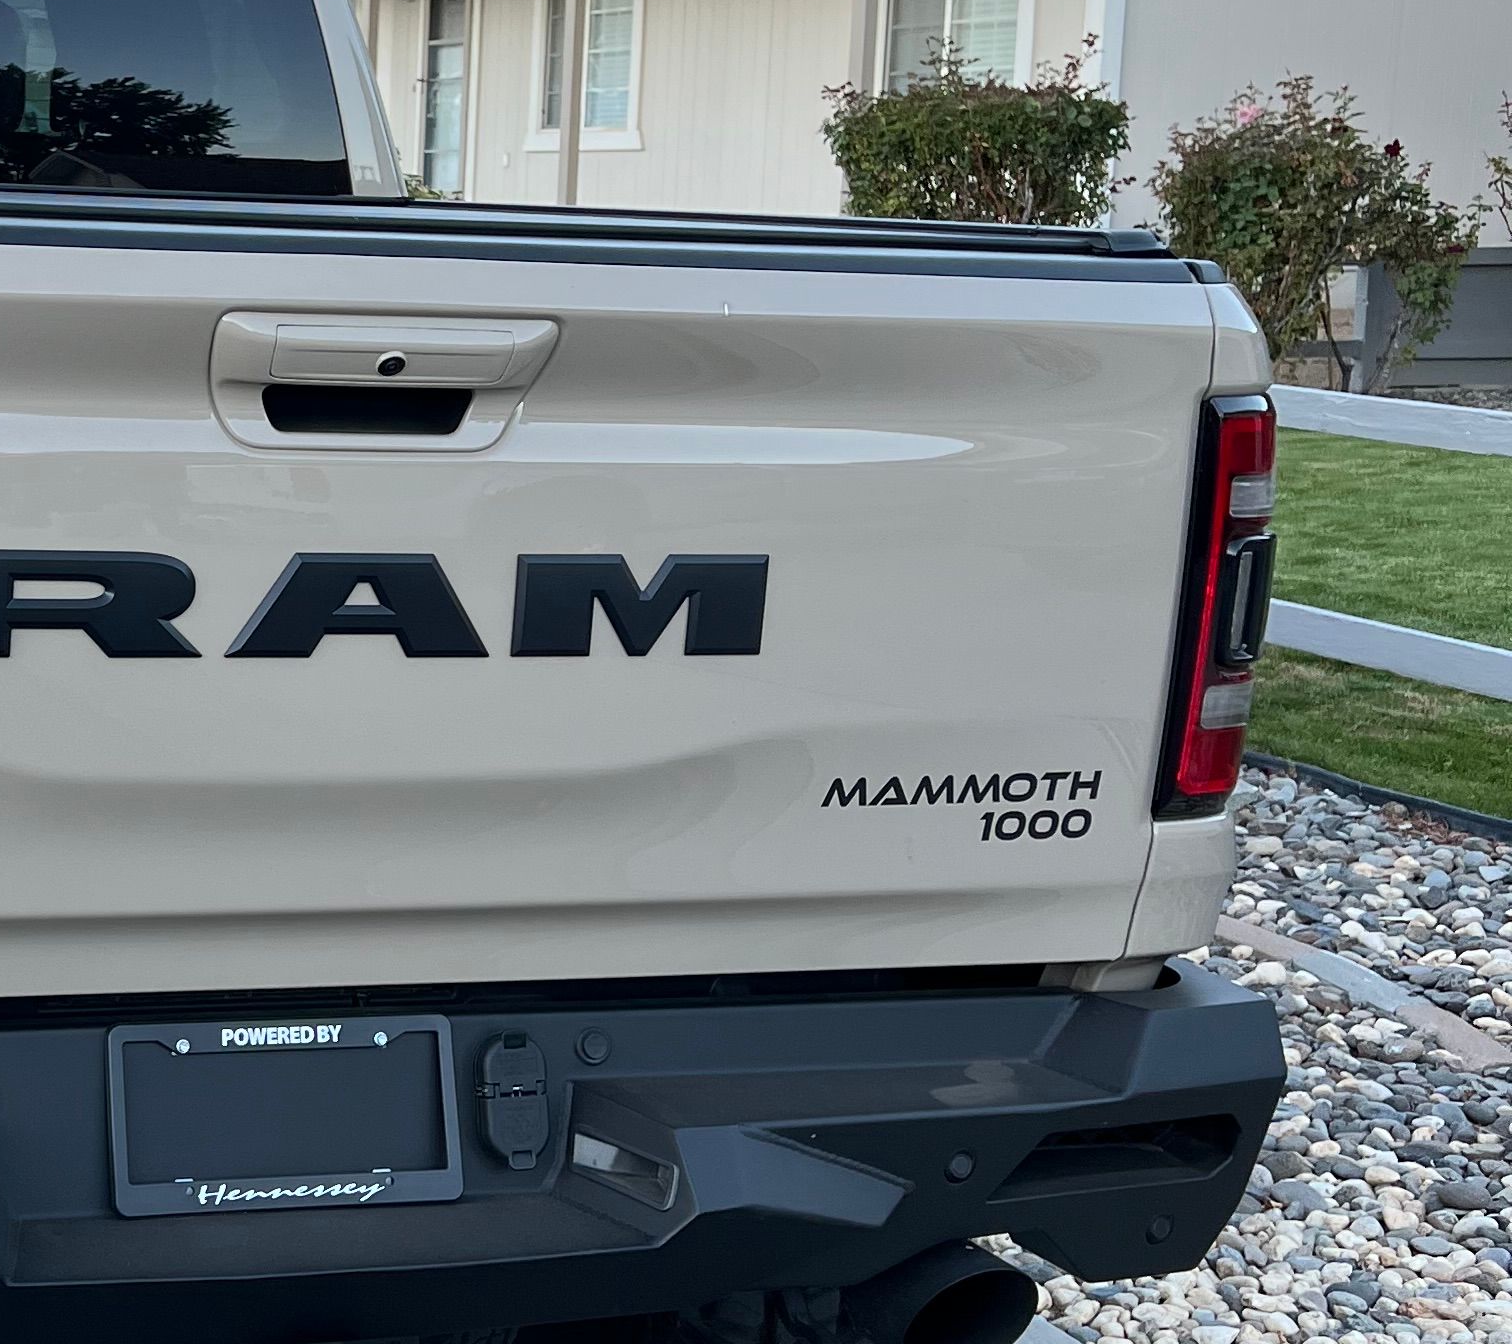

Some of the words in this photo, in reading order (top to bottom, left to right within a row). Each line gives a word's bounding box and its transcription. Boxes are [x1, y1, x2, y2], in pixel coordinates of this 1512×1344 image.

[821, 770, 1102, 807] MAMMOTH
[980, 809, 1092, 841] 1000
[221, 1027, 315, 1047] POWERED
[317, 1025, 342, 1043] BY
[198, 1182, 385, 1205] Hennessey
